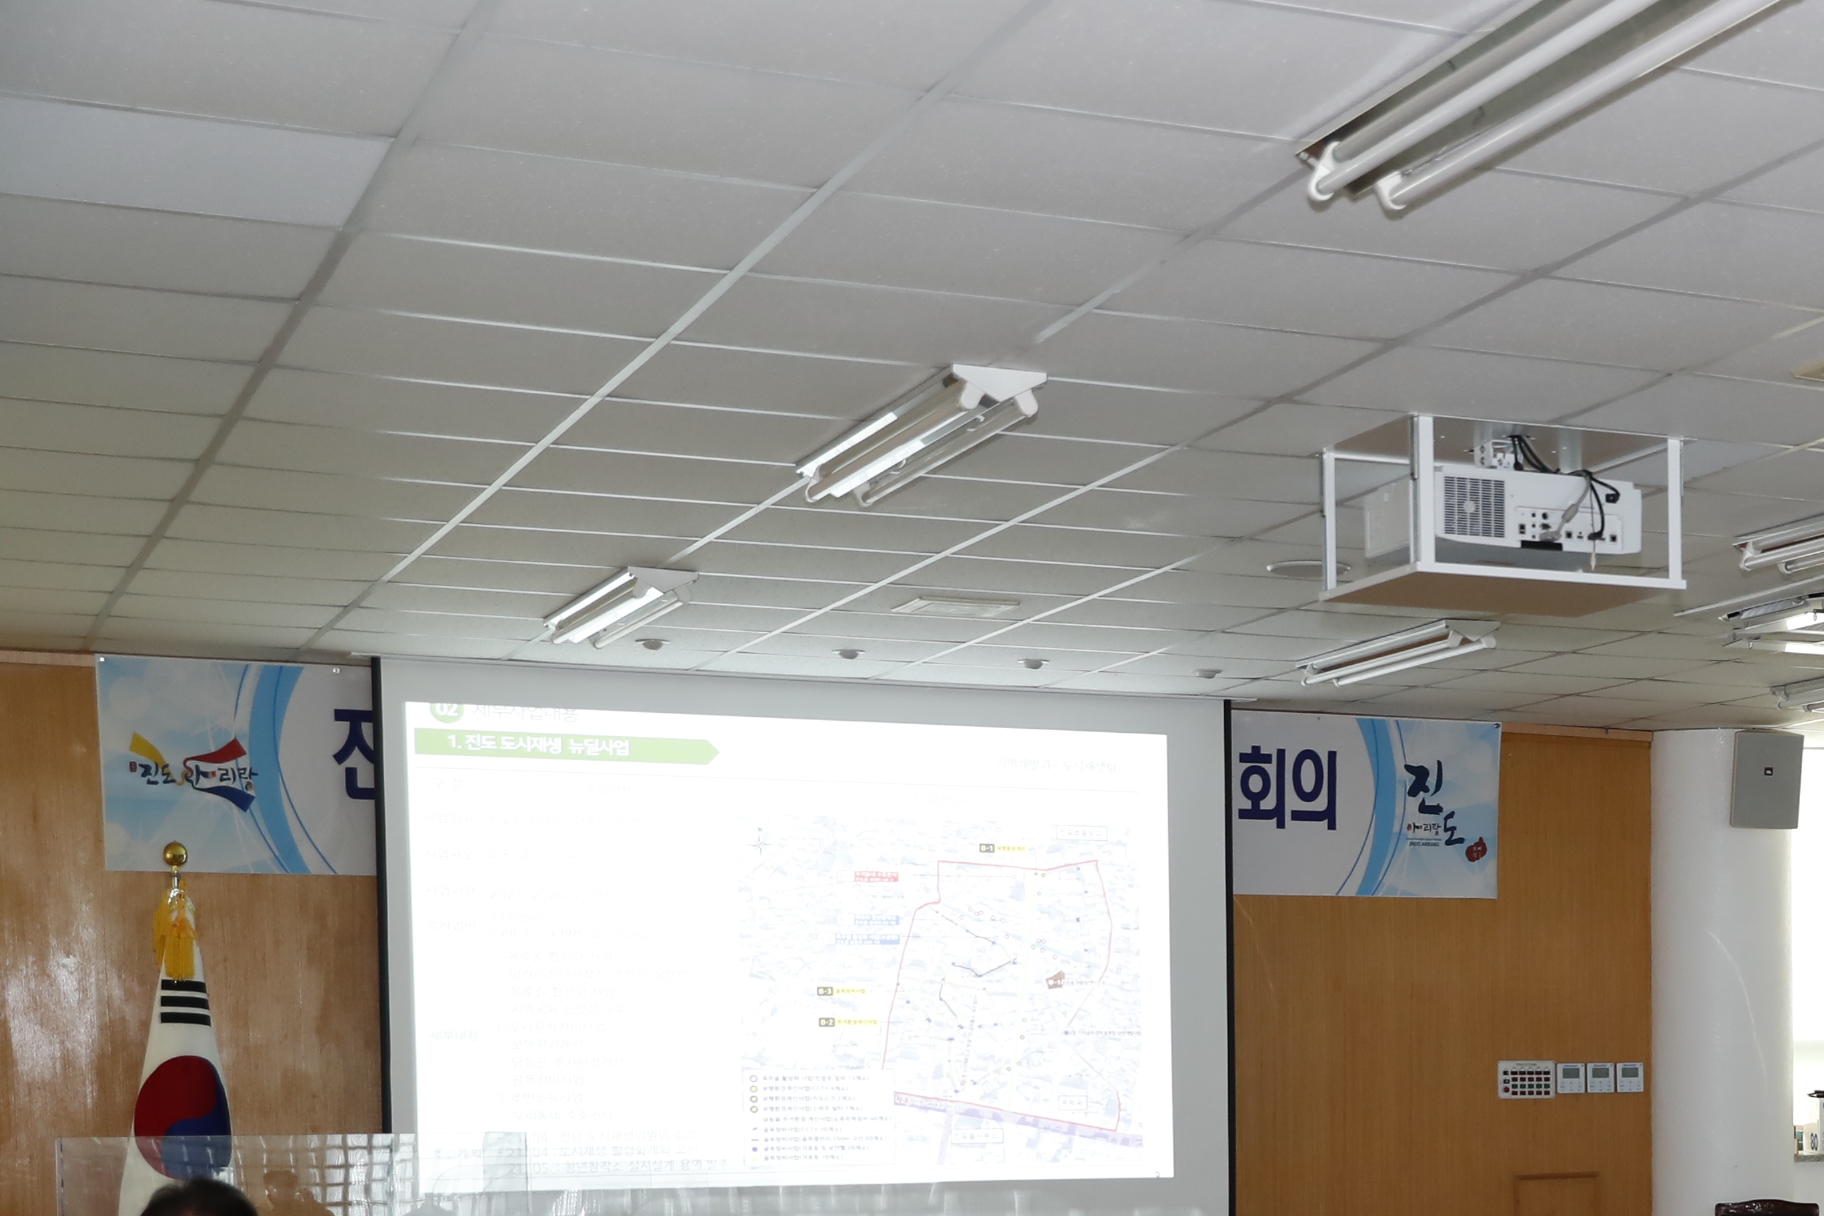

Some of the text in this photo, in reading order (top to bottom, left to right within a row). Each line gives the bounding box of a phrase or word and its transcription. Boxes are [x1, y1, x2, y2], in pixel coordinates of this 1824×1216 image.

[436, 704, 458, 716] 02
[448, 734, 629, 756] 1. 진도 도시재생 뉴딜사업
[140, 763, 177, 785] 진도
[1238, 745, 1338, 831] 회의
[1404, 760, 1465, 846] 진도
[1407, 822, 1441, 835] 아리랑
